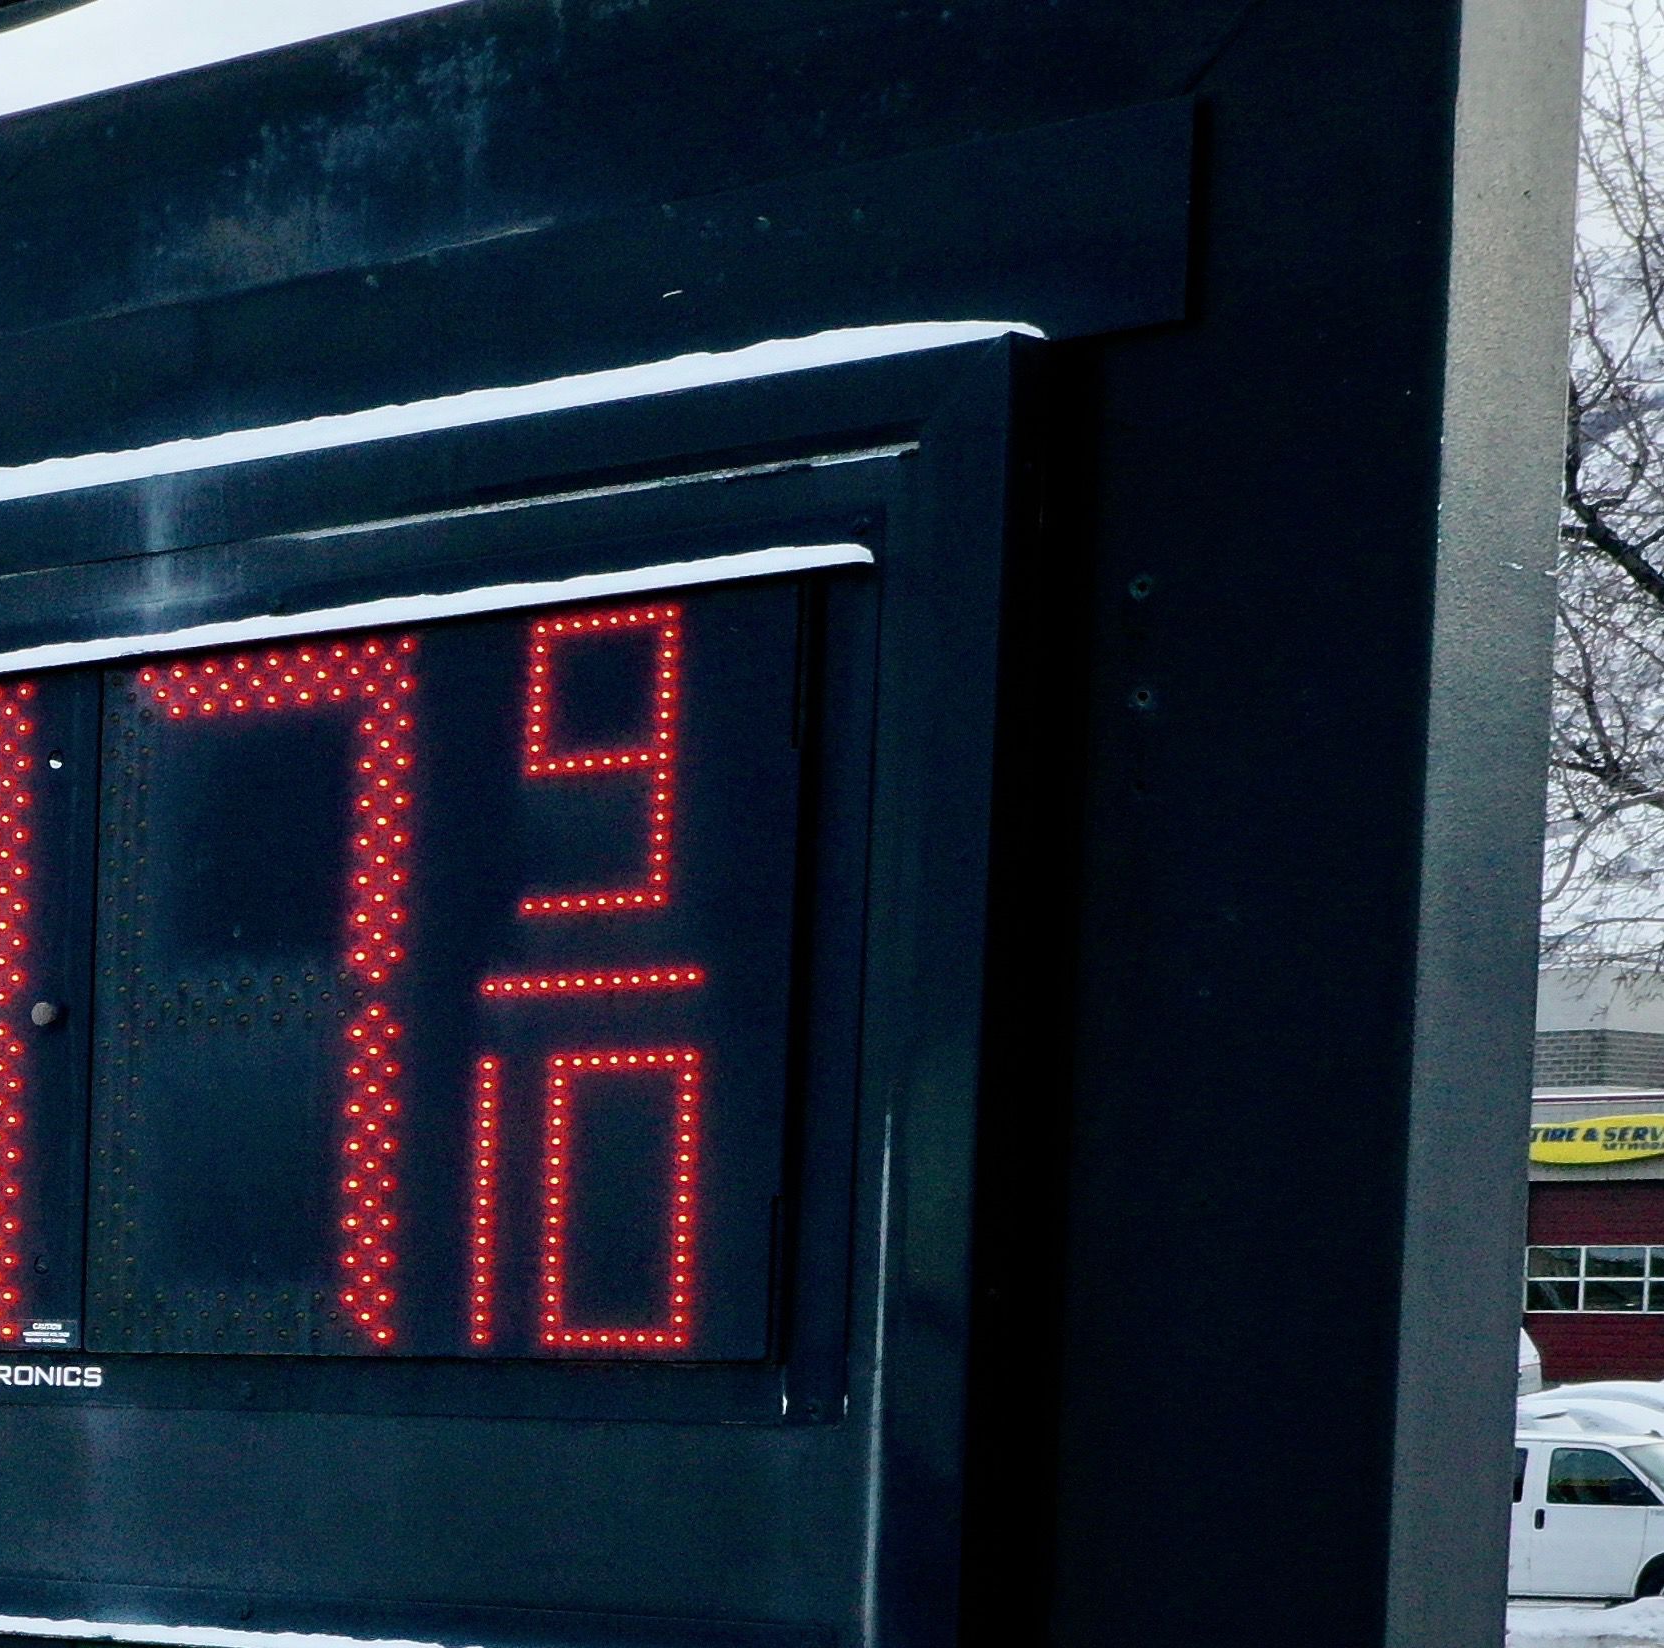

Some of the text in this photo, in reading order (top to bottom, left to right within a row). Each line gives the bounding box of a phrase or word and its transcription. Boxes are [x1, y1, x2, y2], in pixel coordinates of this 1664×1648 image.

[519, 604, 681, 916] 9
[470, 1046, 703, 1349] 10
[1582, 1127, 1598, 1142] &
